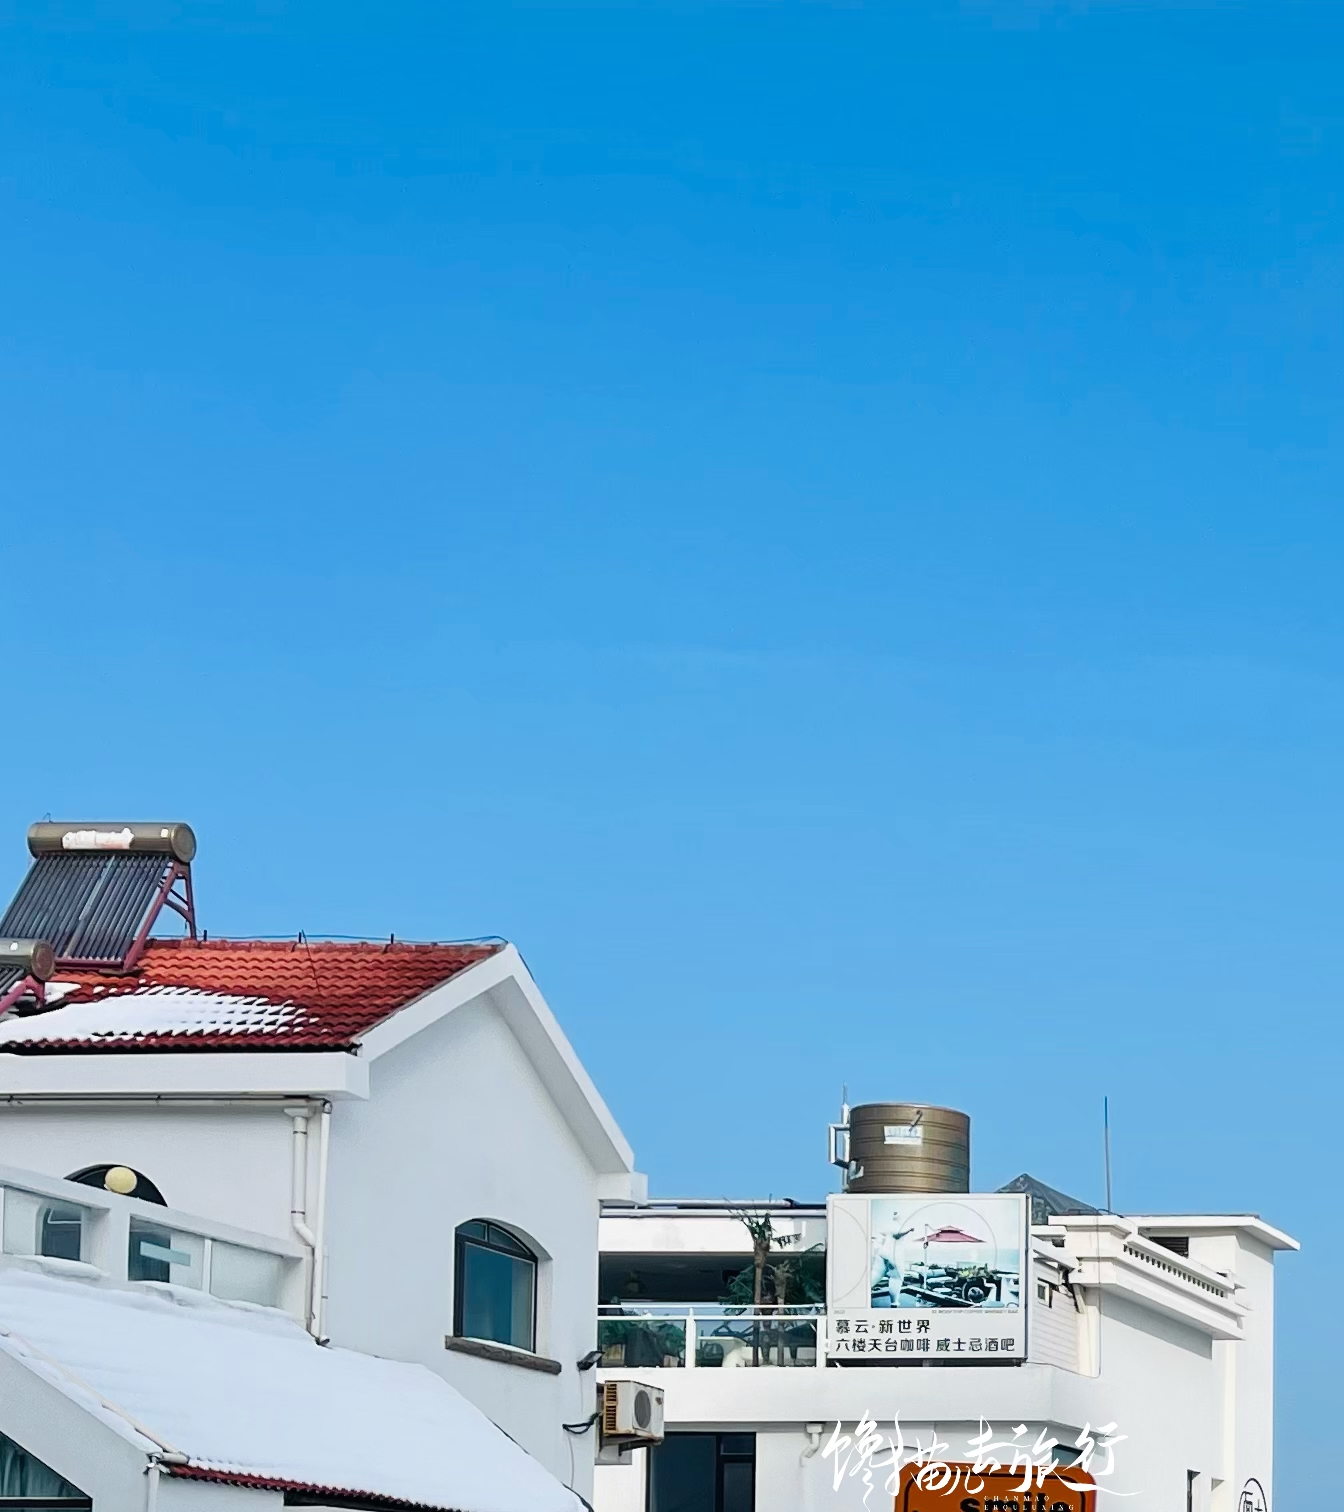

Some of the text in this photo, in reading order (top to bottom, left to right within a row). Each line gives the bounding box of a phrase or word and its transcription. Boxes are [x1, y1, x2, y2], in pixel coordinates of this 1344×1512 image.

[835, 1338, 1015, 1352] 六楼天台咖啡 威士忌酒吧
